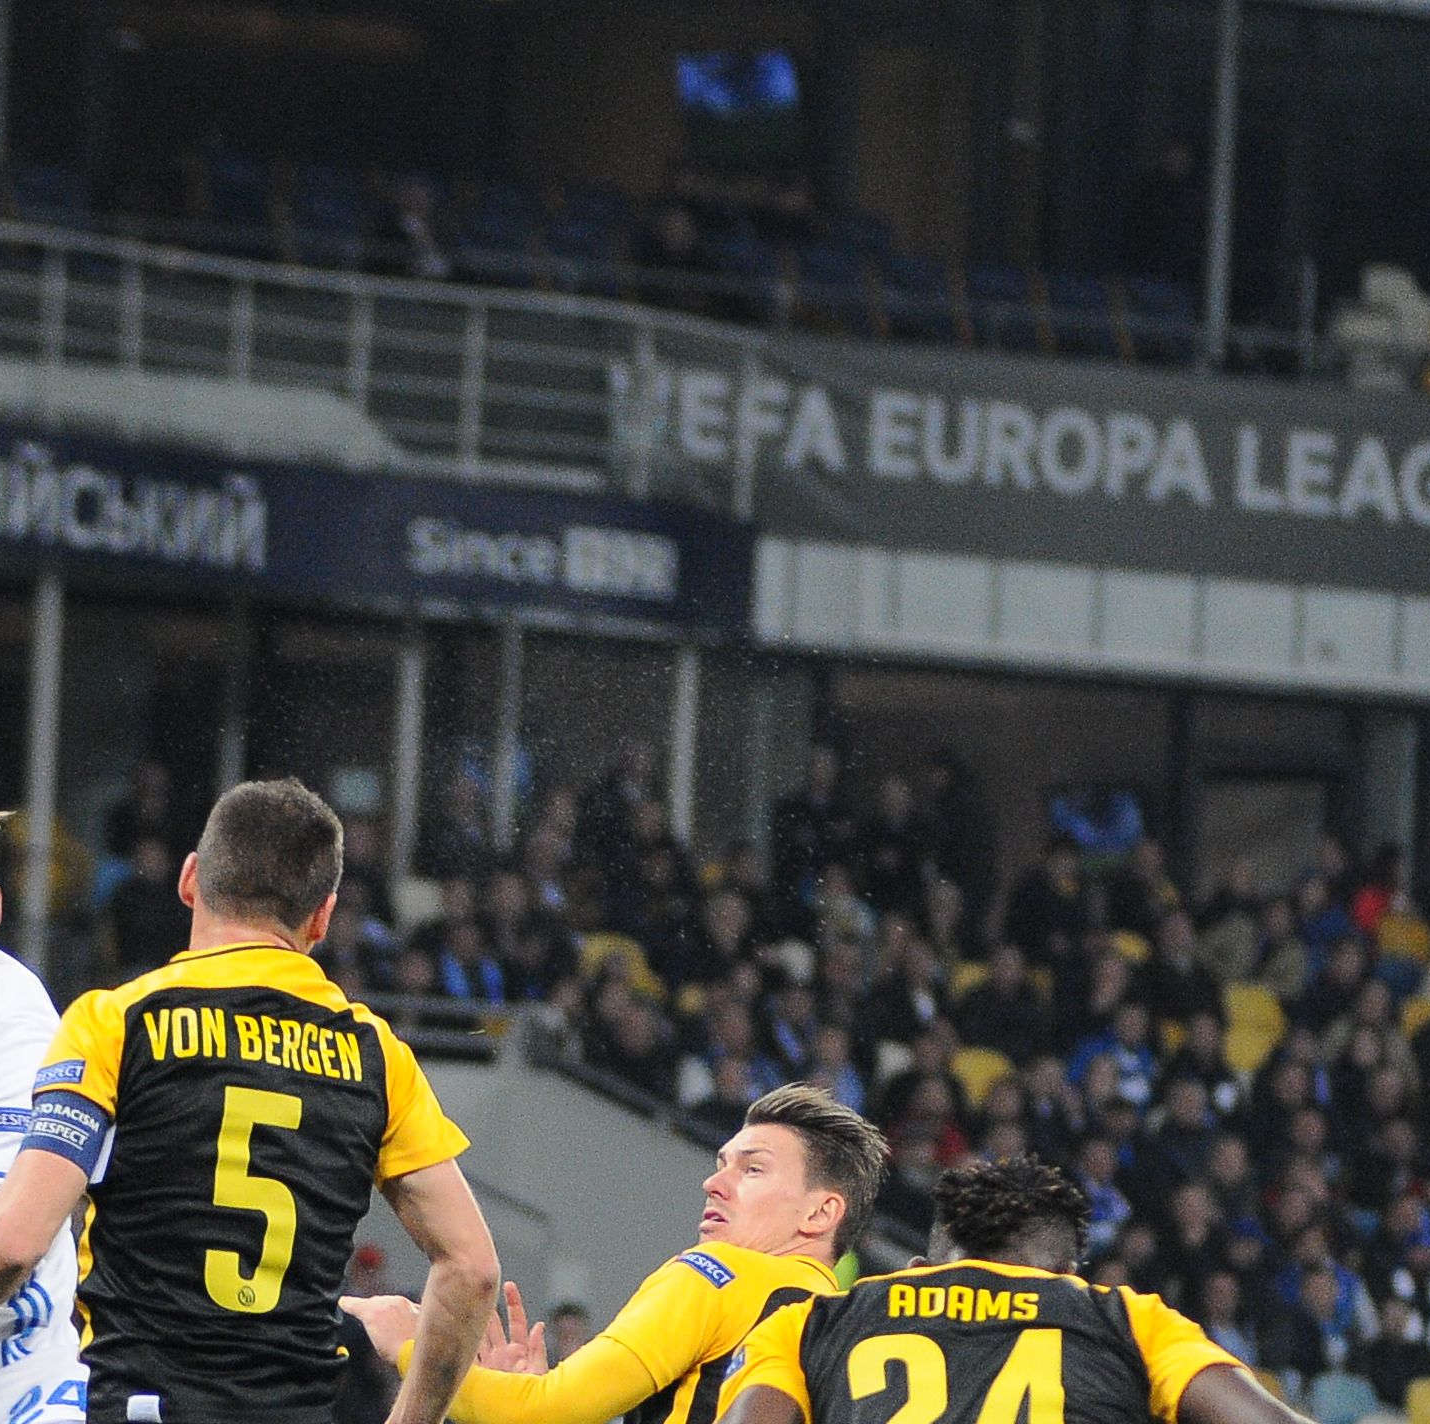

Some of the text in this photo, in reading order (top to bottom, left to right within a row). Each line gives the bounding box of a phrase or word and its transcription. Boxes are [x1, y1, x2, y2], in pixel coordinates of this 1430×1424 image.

[868, 386, 1216, 509] EUROPA
[407, 515, 559, 585] Since
[143, 1006, 364, 1083] VON BERGEN
[34, 1121, 88, 1146] RESPECT
[53, 1103, 100, 1132] RACISM
[203, 1085, 303, 1314] 5
[888, 1283, 1040, 1322] ADAMS
